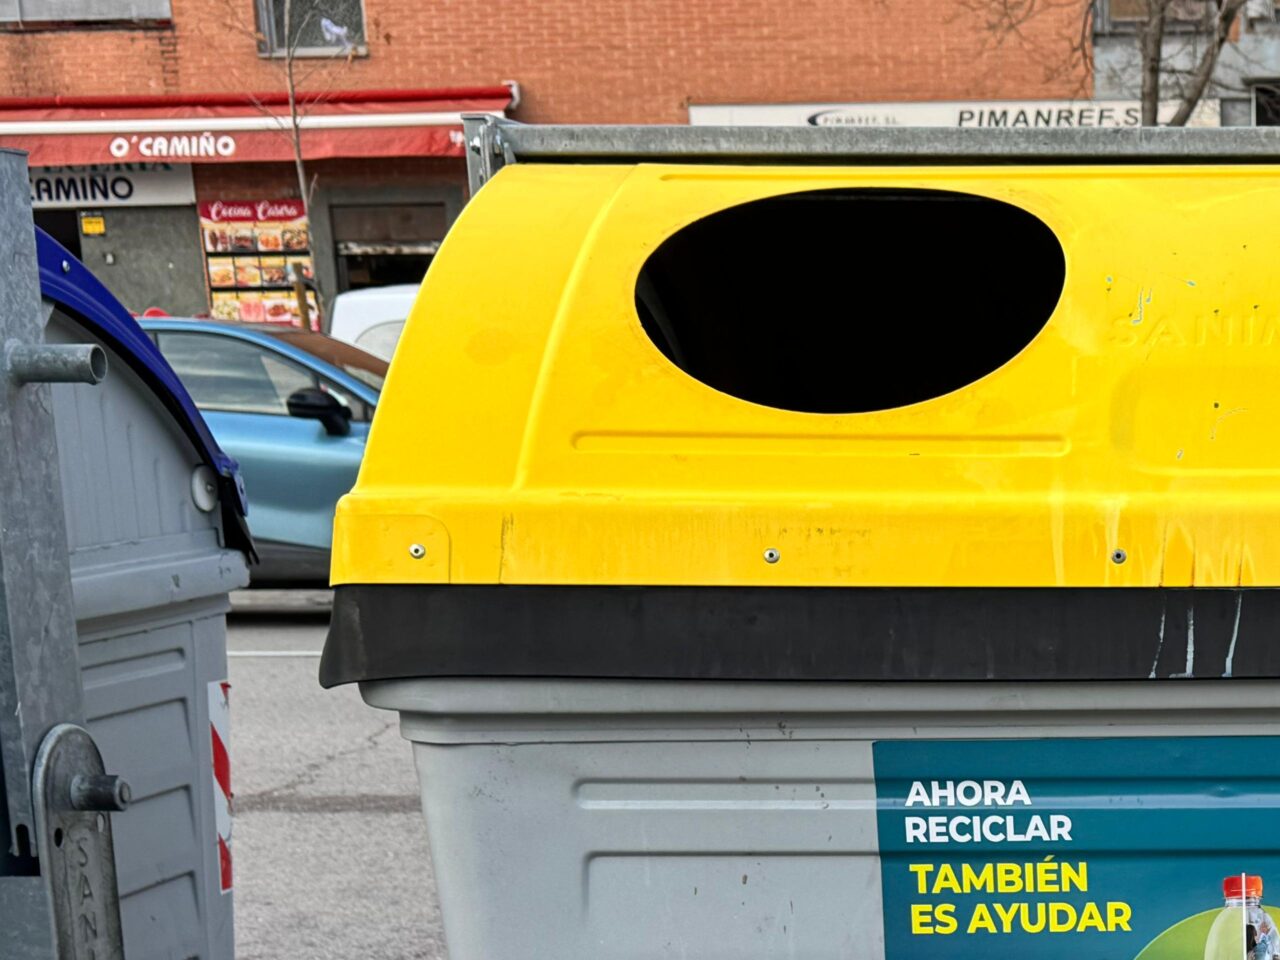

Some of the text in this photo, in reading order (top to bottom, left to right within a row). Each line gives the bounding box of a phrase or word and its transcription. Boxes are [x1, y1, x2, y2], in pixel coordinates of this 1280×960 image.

[208, 200, 298, 221] Cocina Casera
[904, 779, 1033, 807] AHORA
[904, 814, 1073, 844] RECICLAR
[909, 855, 1089, 895] TAMBIÉN
[910, 901, 1132, 936] ES AYUDAR
